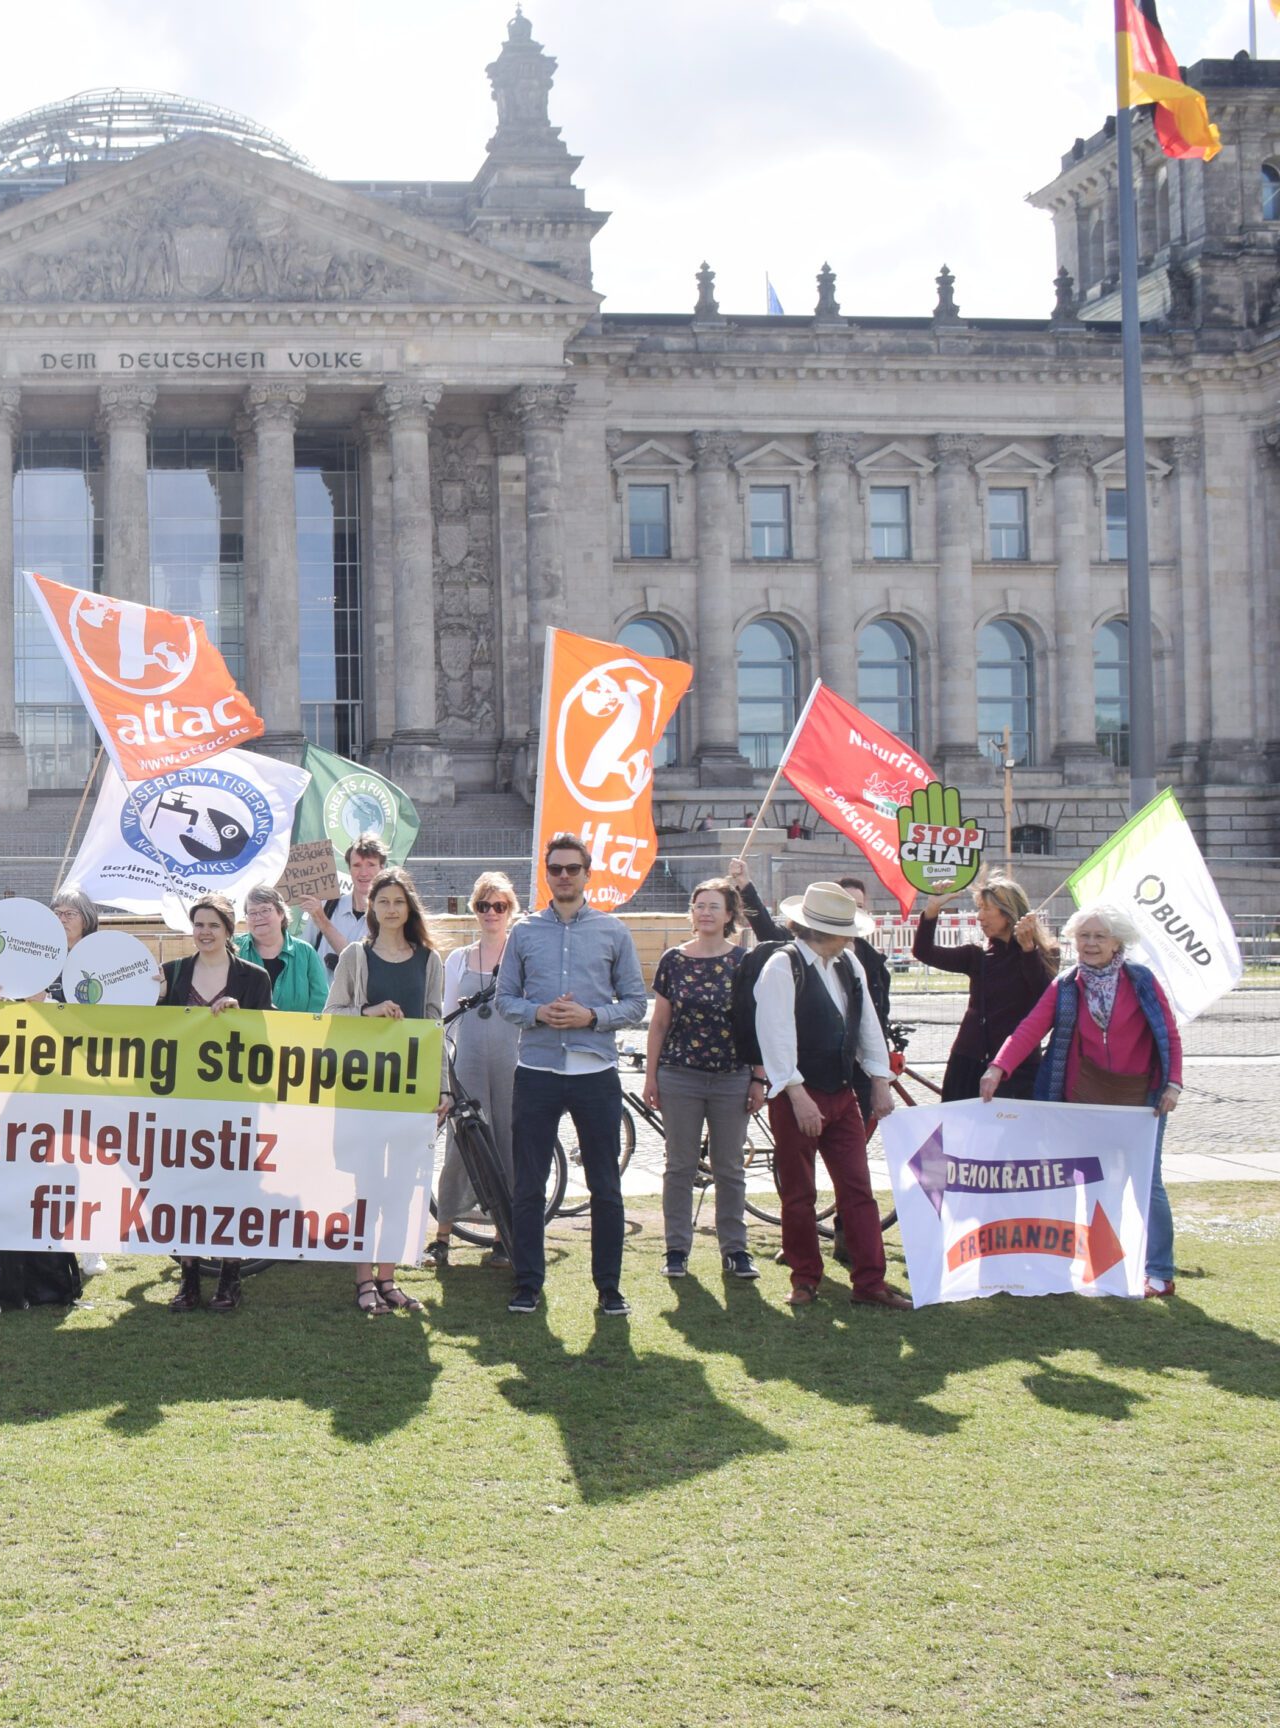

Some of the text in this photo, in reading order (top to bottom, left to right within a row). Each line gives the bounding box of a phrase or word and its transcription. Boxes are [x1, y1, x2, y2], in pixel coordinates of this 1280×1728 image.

[40, 351, 363, 370] DEM DEUTSCHEN VOLKE
[116, 695, 241, 746] attac
[848, 729, 934, 784] NaturFre
[123, 771, 270, 845] WASSERPRIVATISIERUNG?
[328, 780, 357, 829] PARENTS
[360, 780, 366, 790] 4
[912, 825, 980, 846] STOP
[134, 837, 238, 878] NEIN DANKE!
[900, 842, 971, 865] CETA!
[102, 864, 161, 879] Berliner
[6, 935, 61, 955] Umweltinstitut
[1151, 903, 1212, 966] BUND
[8, 943, 58, 961] München e.V.
[98, 958, 150, 981] Umweltinstitut
[104, 966, 151, 986] München e.V.
[197, 1030, 420, 1104] stoppen!
[945, 1161, 1066, 1189] DEMOKRATIE
[30, 1184, 368, 1252] für Konzerne!
